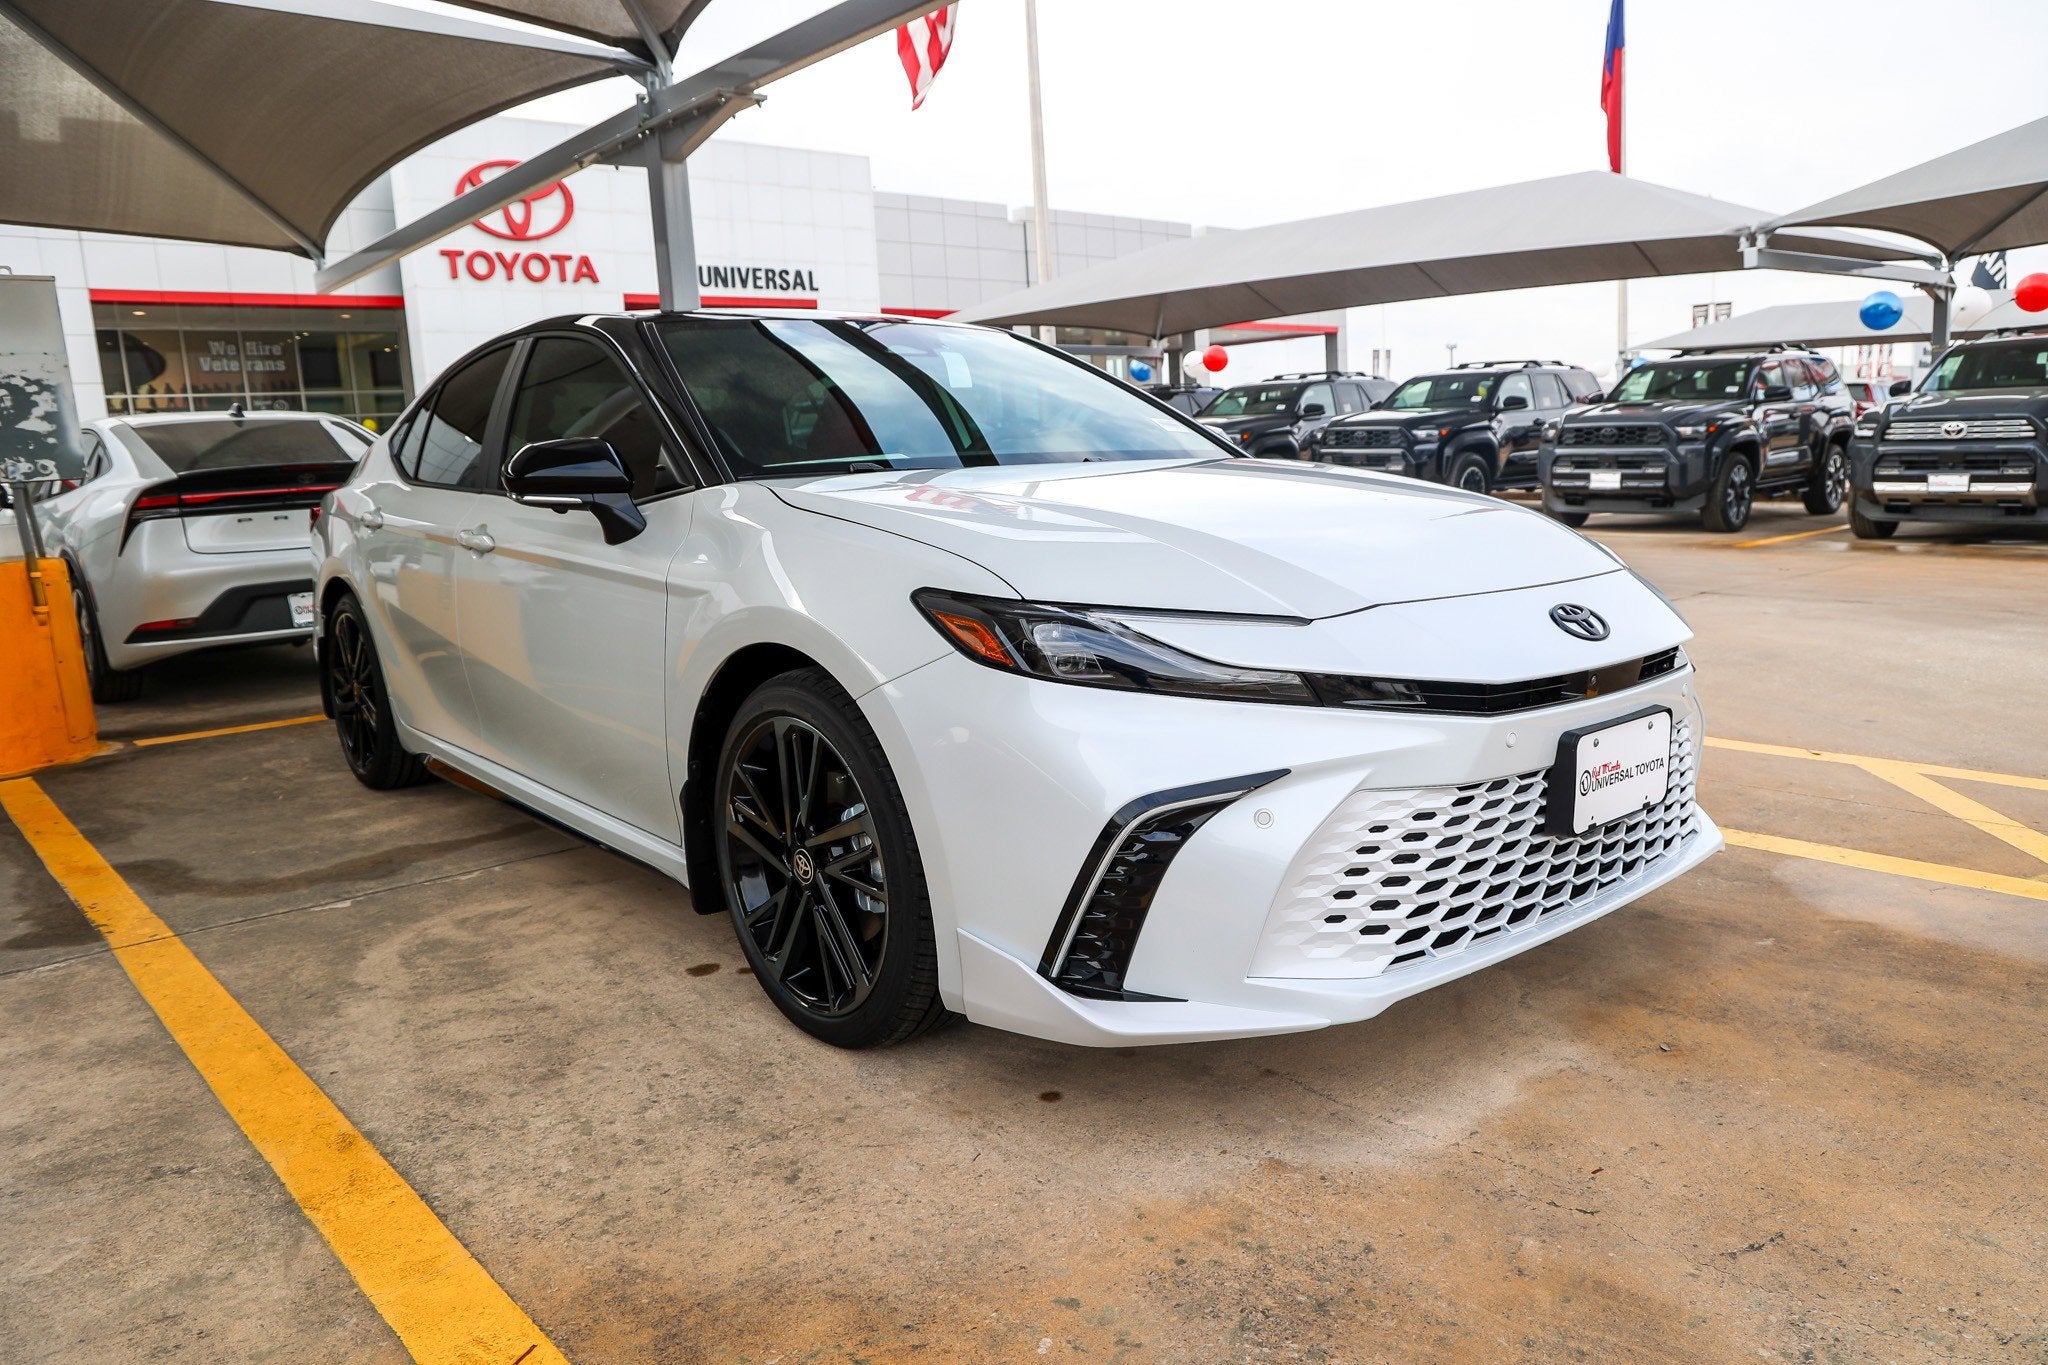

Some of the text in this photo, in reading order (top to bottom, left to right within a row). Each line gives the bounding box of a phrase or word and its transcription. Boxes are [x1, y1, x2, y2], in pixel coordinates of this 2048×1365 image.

[440, 249, 600, 283] TOYOTA
[698, 265, 819, 291] UNIVERSAL
[208, 340, 282, 355] We Hire
[1591, 757, 1665, 792] UNIVERSAL TOYOTA
